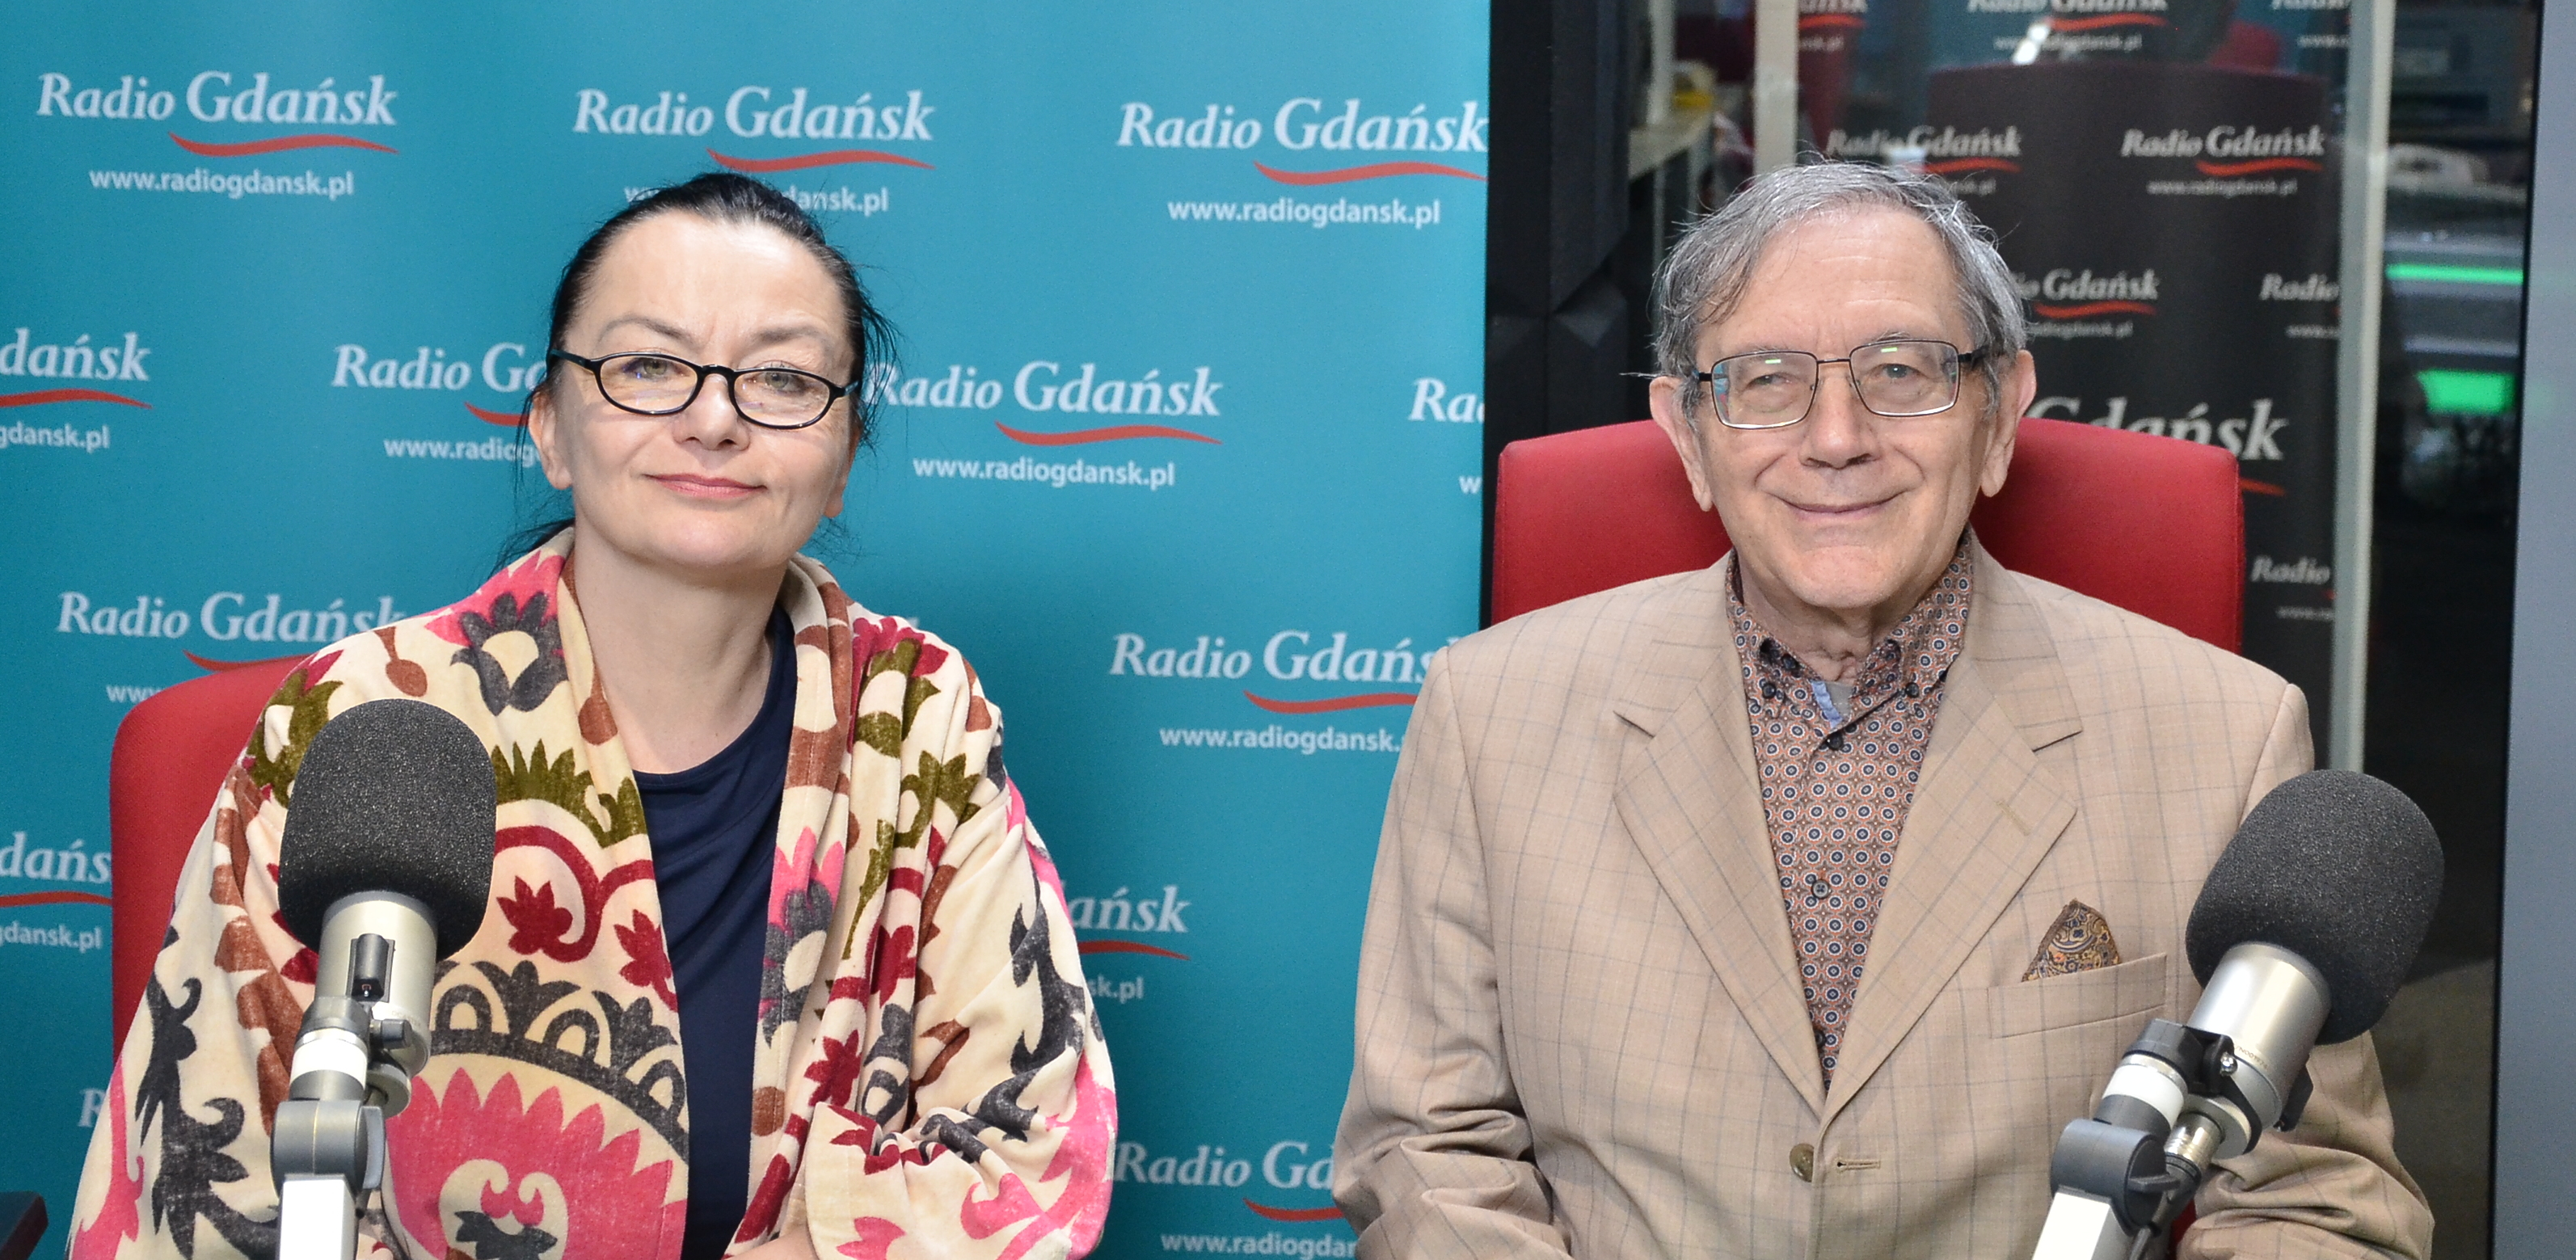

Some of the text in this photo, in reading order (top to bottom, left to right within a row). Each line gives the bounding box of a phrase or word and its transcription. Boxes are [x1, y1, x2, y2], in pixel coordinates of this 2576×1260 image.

[36, 70, 398, 125] Radio Gdańsk
[573, 85, 935, 141] Radio Gdańsk
[1117, 97, 1488, 152] Radio Gdańsk
[2121, 124, 2325, 157] Radio Gdańsk
[89, 168, 354, 200] www.radiogdansk.pl
[1167, 197, 1441, 229] www.radiogdansk.pl
[331, 343, 472, 390] Radio
[864, 360, 1224, 416] Radio Gdańsk
[912, 457, 1176, 491] www.radiogdansk.pl
[56, 591, 191, 639] Radio
[1109, 629, 1462, 684] Radio Gdańs
[1158, 725, 1404, 755] www.radiogdansk.
[1069, 884, 1191, 933] ańsk
[1114, 1141, 1252, 1187] Radio
